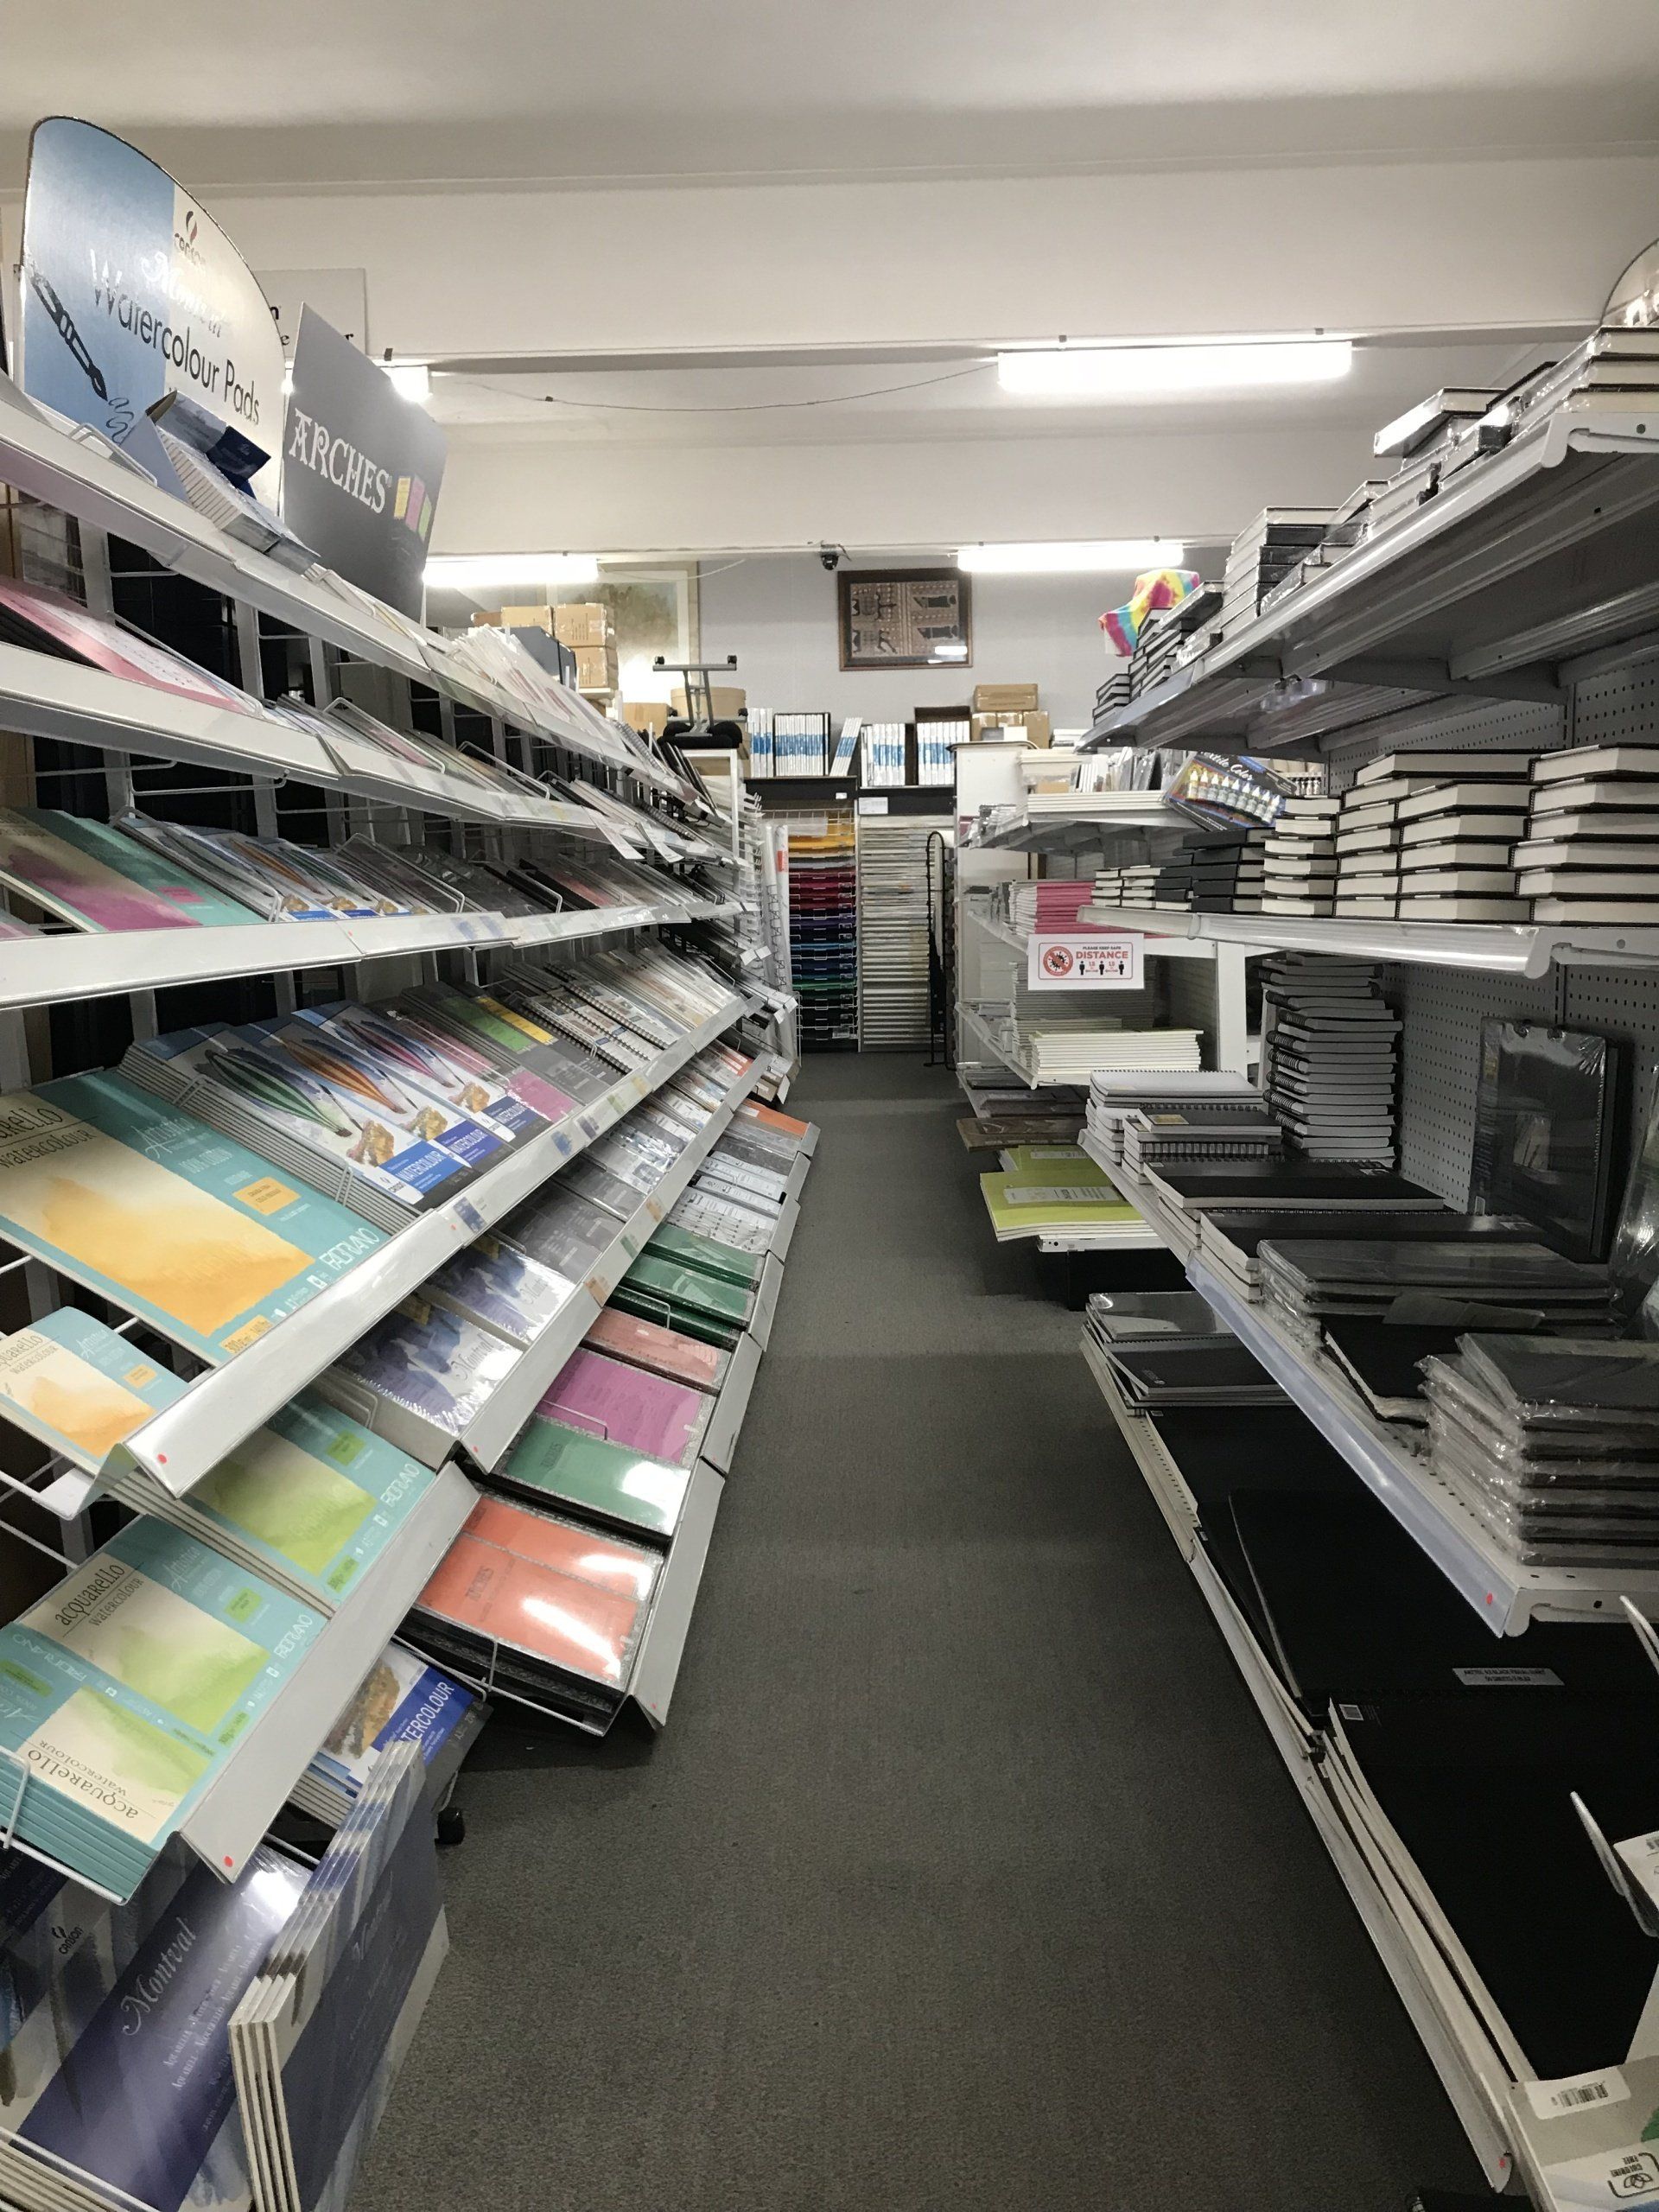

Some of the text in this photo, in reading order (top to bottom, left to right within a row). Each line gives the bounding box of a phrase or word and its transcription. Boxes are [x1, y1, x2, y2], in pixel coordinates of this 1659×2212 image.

[90, 248, 260, 426] Watercolour Pads
[1076, 950, 1128, 959] DISTANCE
[397, 1150, 447, 1182] WATERCOLOUR
[400, 1681, 456, 1742] TERCOLOUR
[120, 1916, 196, 2037] Montval
